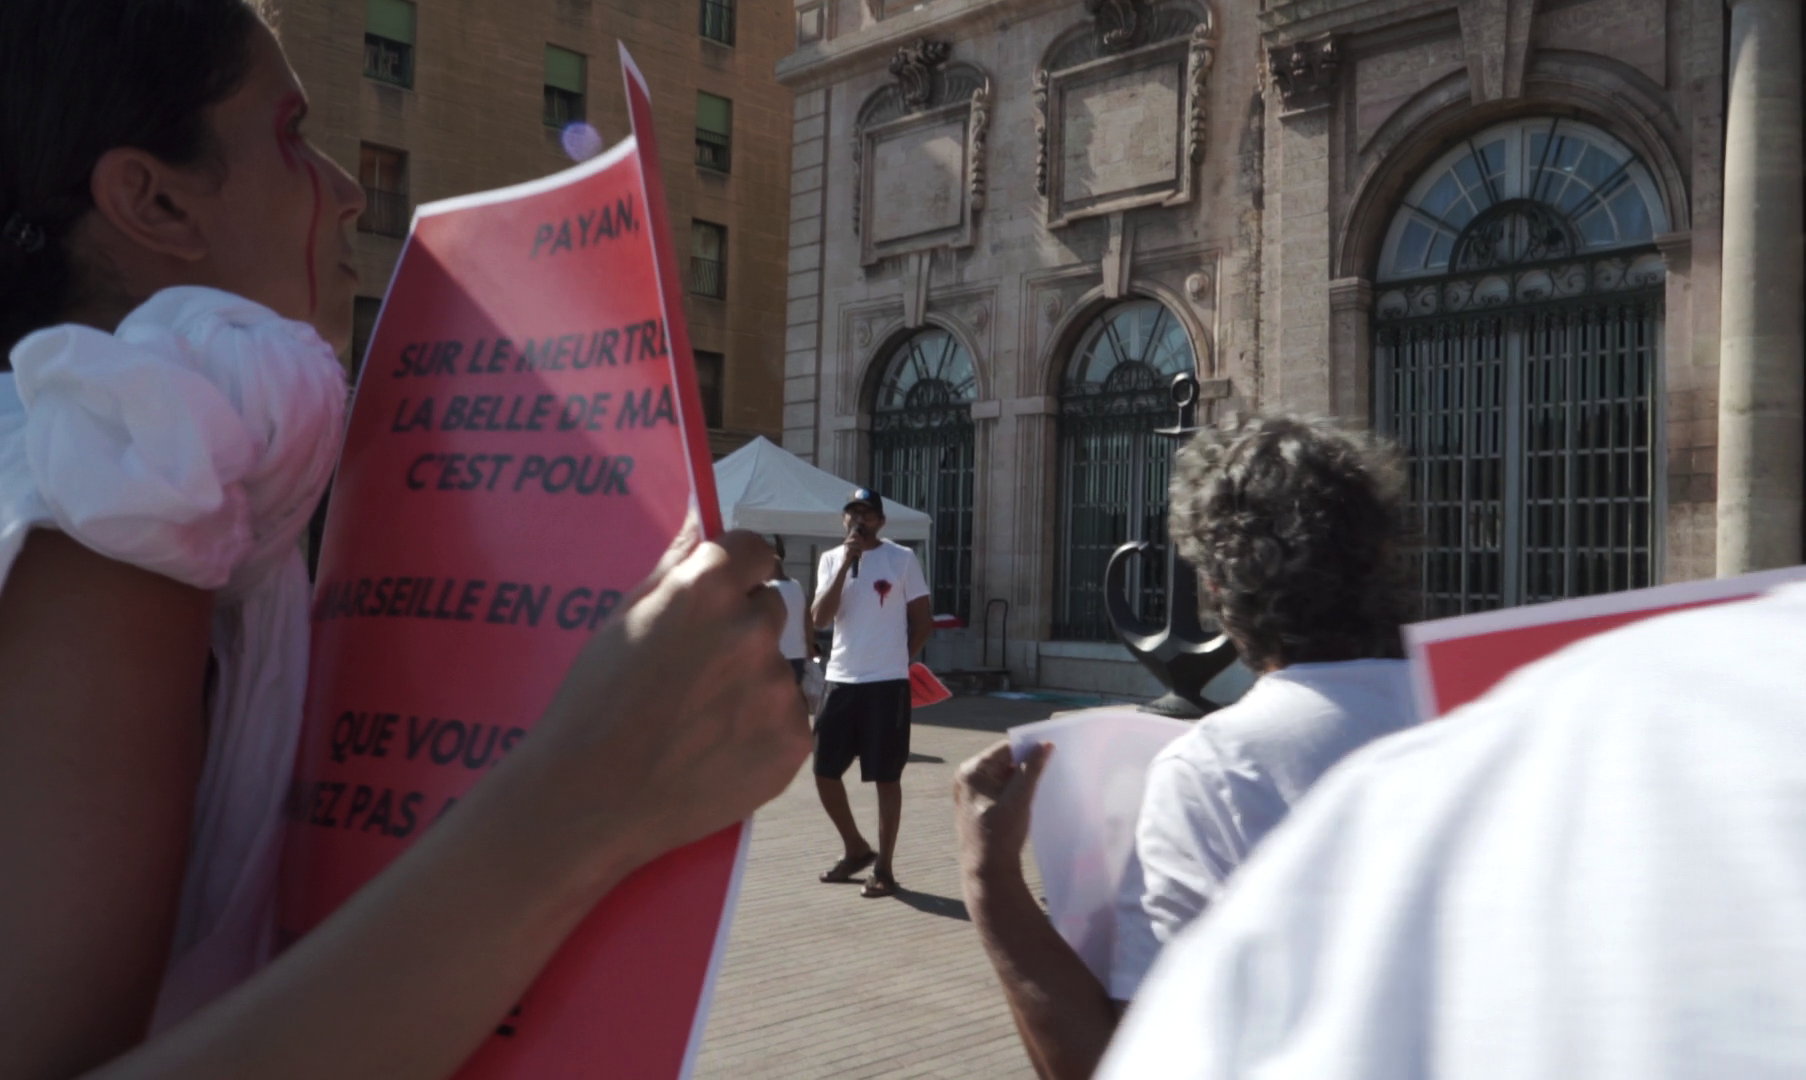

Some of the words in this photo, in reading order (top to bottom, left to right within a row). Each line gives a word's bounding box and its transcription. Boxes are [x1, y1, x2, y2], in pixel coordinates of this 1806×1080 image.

[531, 195, 639, 258] PAYAN,
[393, 339, 462, 378] SUR
[466, 337, 514, 376] LE
[391, 397, 431, 433] LA
[440, 394, 553, 432] BELLE
[557, 391, 612, 432] DE
[406, 452, 513, 492] C'EST
[513, 454, 635, 496] POUR
[314, 576, 489, 623] MARSEILLE
[486, 580, 553, 629] EN
[331, 710, 401, 764] QUE
[343, 784, 427, 839] PAS
